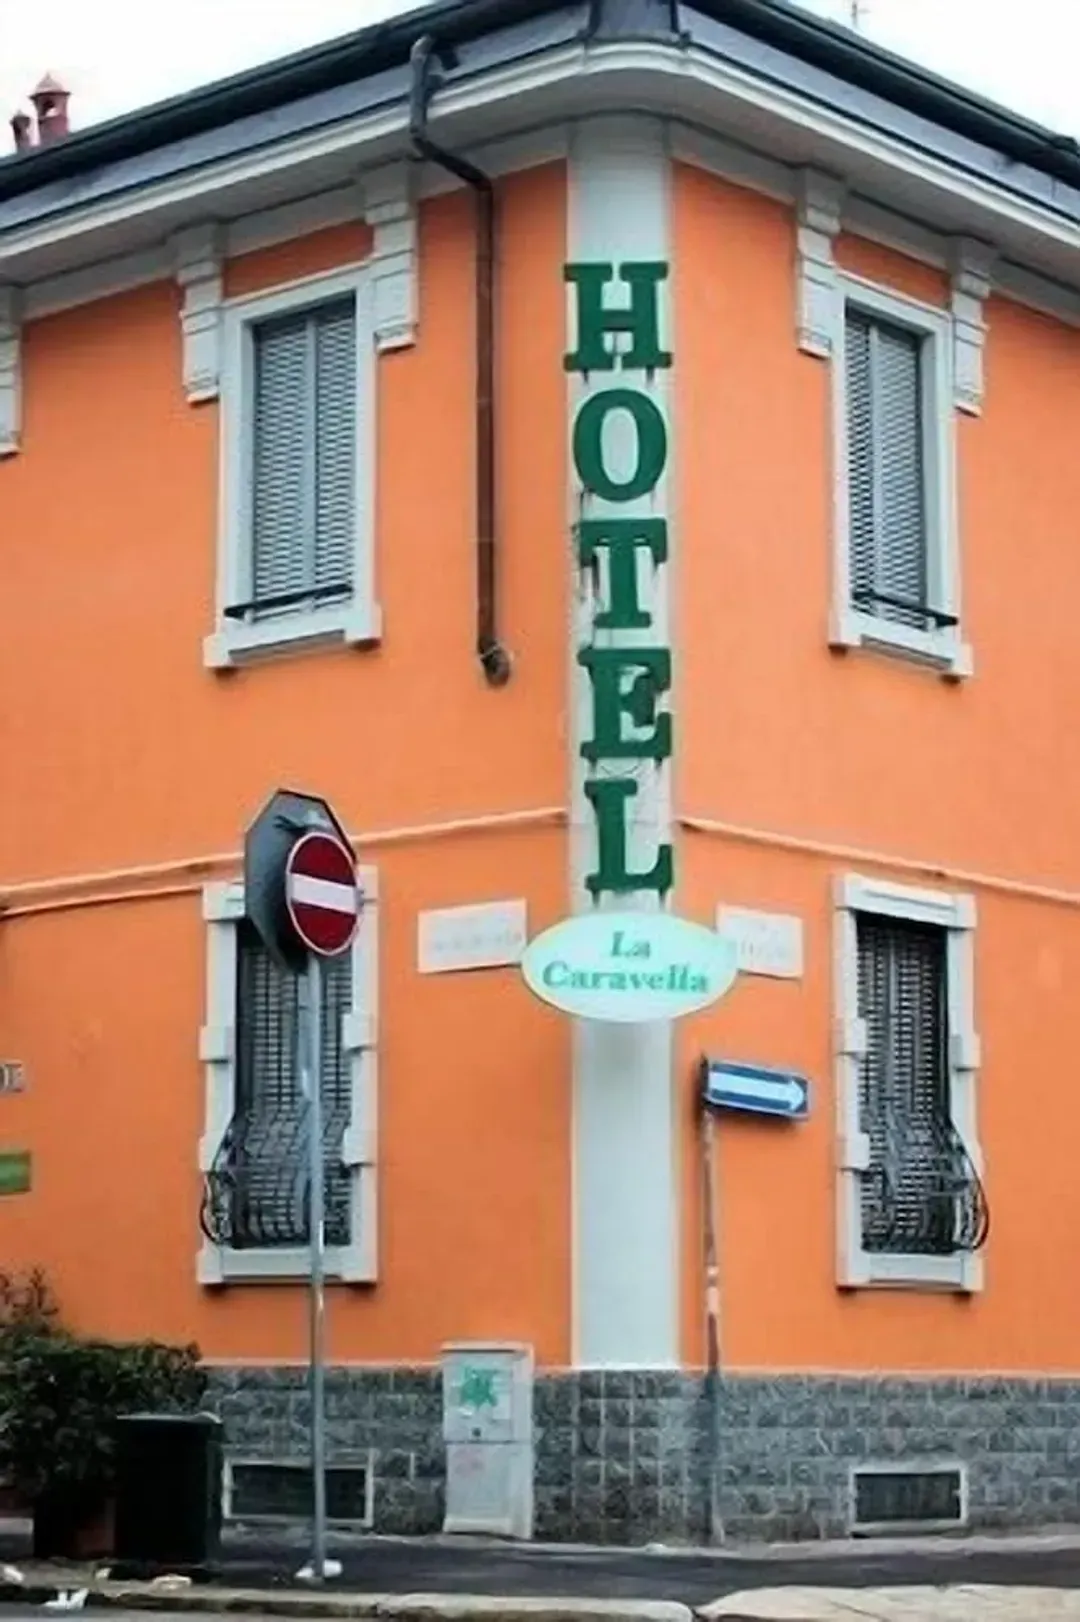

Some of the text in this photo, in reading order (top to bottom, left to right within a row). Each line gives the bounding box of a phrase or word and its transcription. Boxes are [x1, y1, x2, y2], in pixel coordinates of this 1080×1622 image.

[563, 261, 674, 893] HOTEL
[609, 930, 651, 959] La
[542, 960, 709, 994] Caravella
